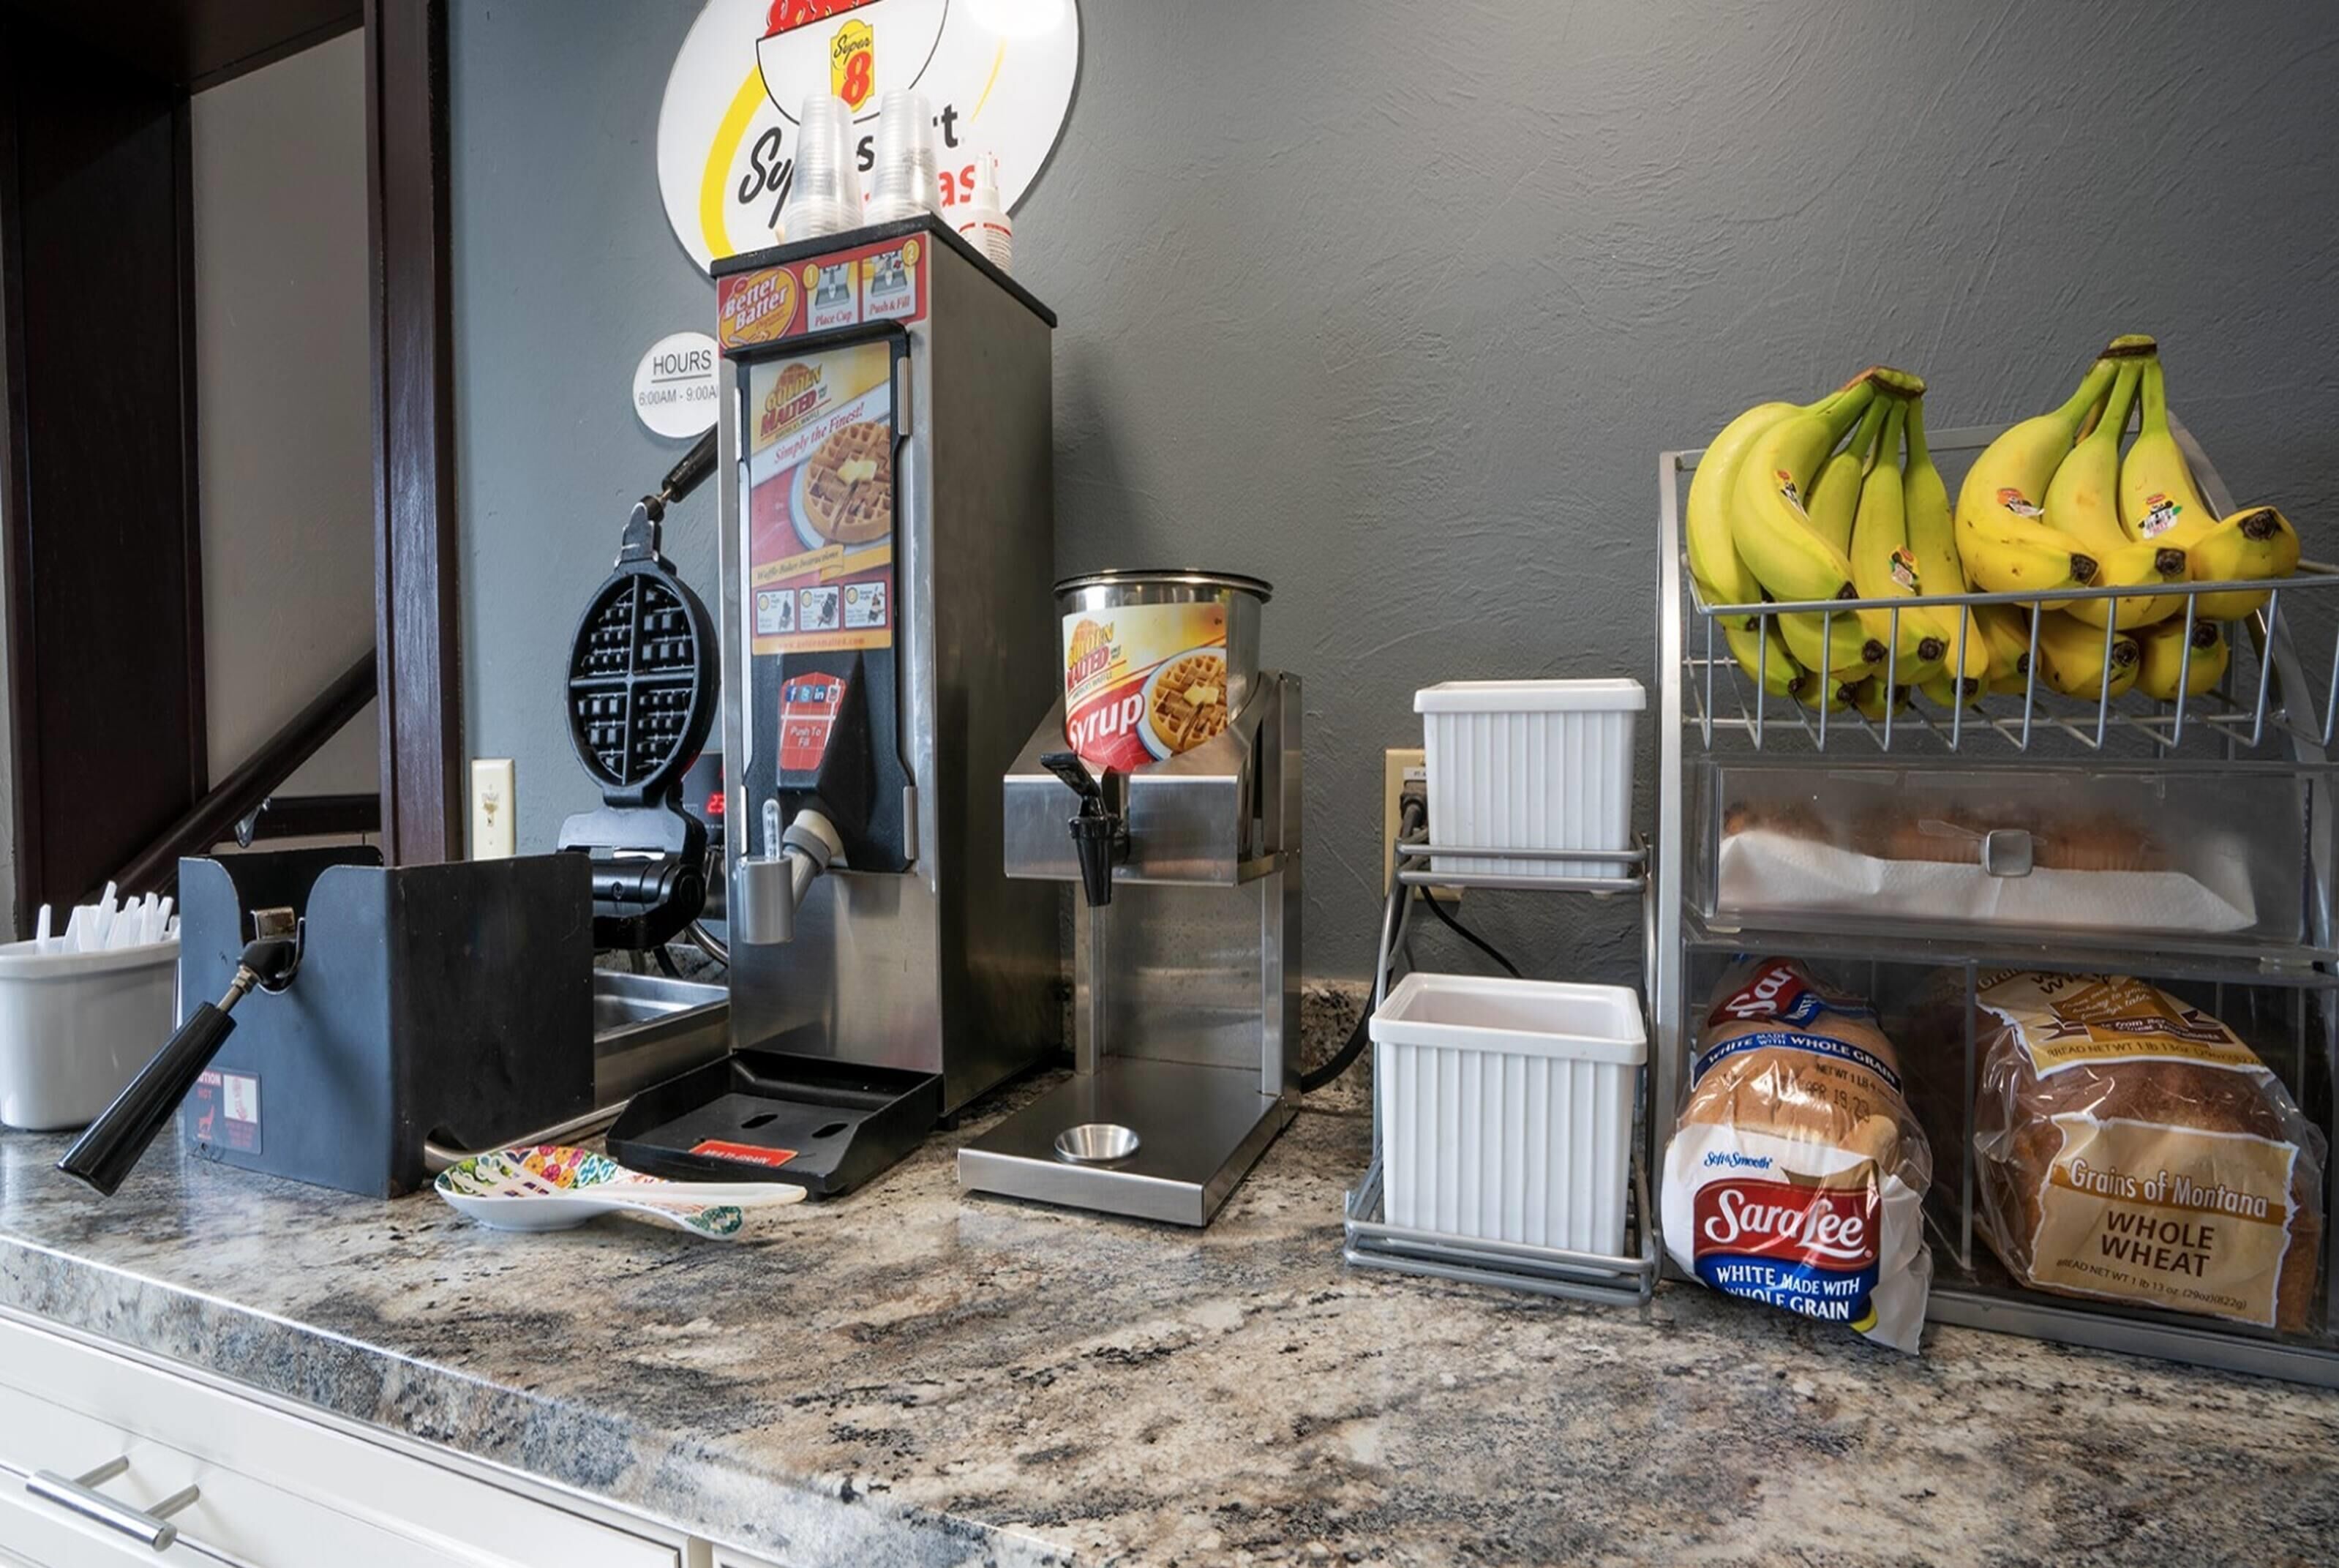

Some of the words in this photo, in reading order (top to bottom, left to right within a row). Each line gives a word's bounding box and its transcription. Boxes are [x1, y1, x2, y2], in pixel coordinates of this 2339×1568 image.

[833, 34, 871, 64] Super
[841, 50, 871, 105] 8
[726, 274, 778, 319] Better
[735, 284, 788, 332] Batter
[869, 299, 889, 315] Push
[896, 295, 911, 307] Fill
[814, 312, 835, 327] Place
[836, 308, 852, 323] Cup
[653, 350, 712, 375] HOURS
[639, 389, 677, 406] 6:00AM
[686, 385, 719, 402] 9:00A
[774, 436, 808, 464] Simply
[811, 425, 827, 445] the
[828, 402, 866, 434] Finest!
[790, 725, 810, 736] Push
[811, 726, 822, 736] To
[1069, 692, 1144, 754] Syrup
[798, 737, 810, 747] Fill
[1709, 1038, 1754, 1063] WHITE
[1756, 1032, 1785, 1040] MADE
[1790, 1035, 1850, 1056] WHOLE
[1852, 1050, 1896, 1084] GRAIN
[1816, 1064, 1832, 1075] NET
[1834, 1067, 1848, 1080] WT
[1857, 1076, 1869, 1088] LB
[2070, 1159, 2137, 1198] Grains
[2143, 1170, 2169, 1201] of
[2172, 1176, 2269, 1219] Montana
[2108, 1210, 2215, 1250] WHOLE
[2101, 1234, 2210, 1278] WHEAT
[1716, 1264, 1776, 1287] WHITE
[1782, 1272, 1820, 1295] MADE
[1822, 1277, 1861, 1297] WITH
[2056, 1258, 2088, 1272] BREAD
[2089, 1266, 2111, 1278] NET
[2112, 1271, 2130, 1282] WT
[2139, 1276, 2150, 1288] lb
[2152, 1280, 2164, 1292] 13
[2165, 1286, 2179, 1295] oz
[1790, 1296, 1850, 1321] GRAIN
